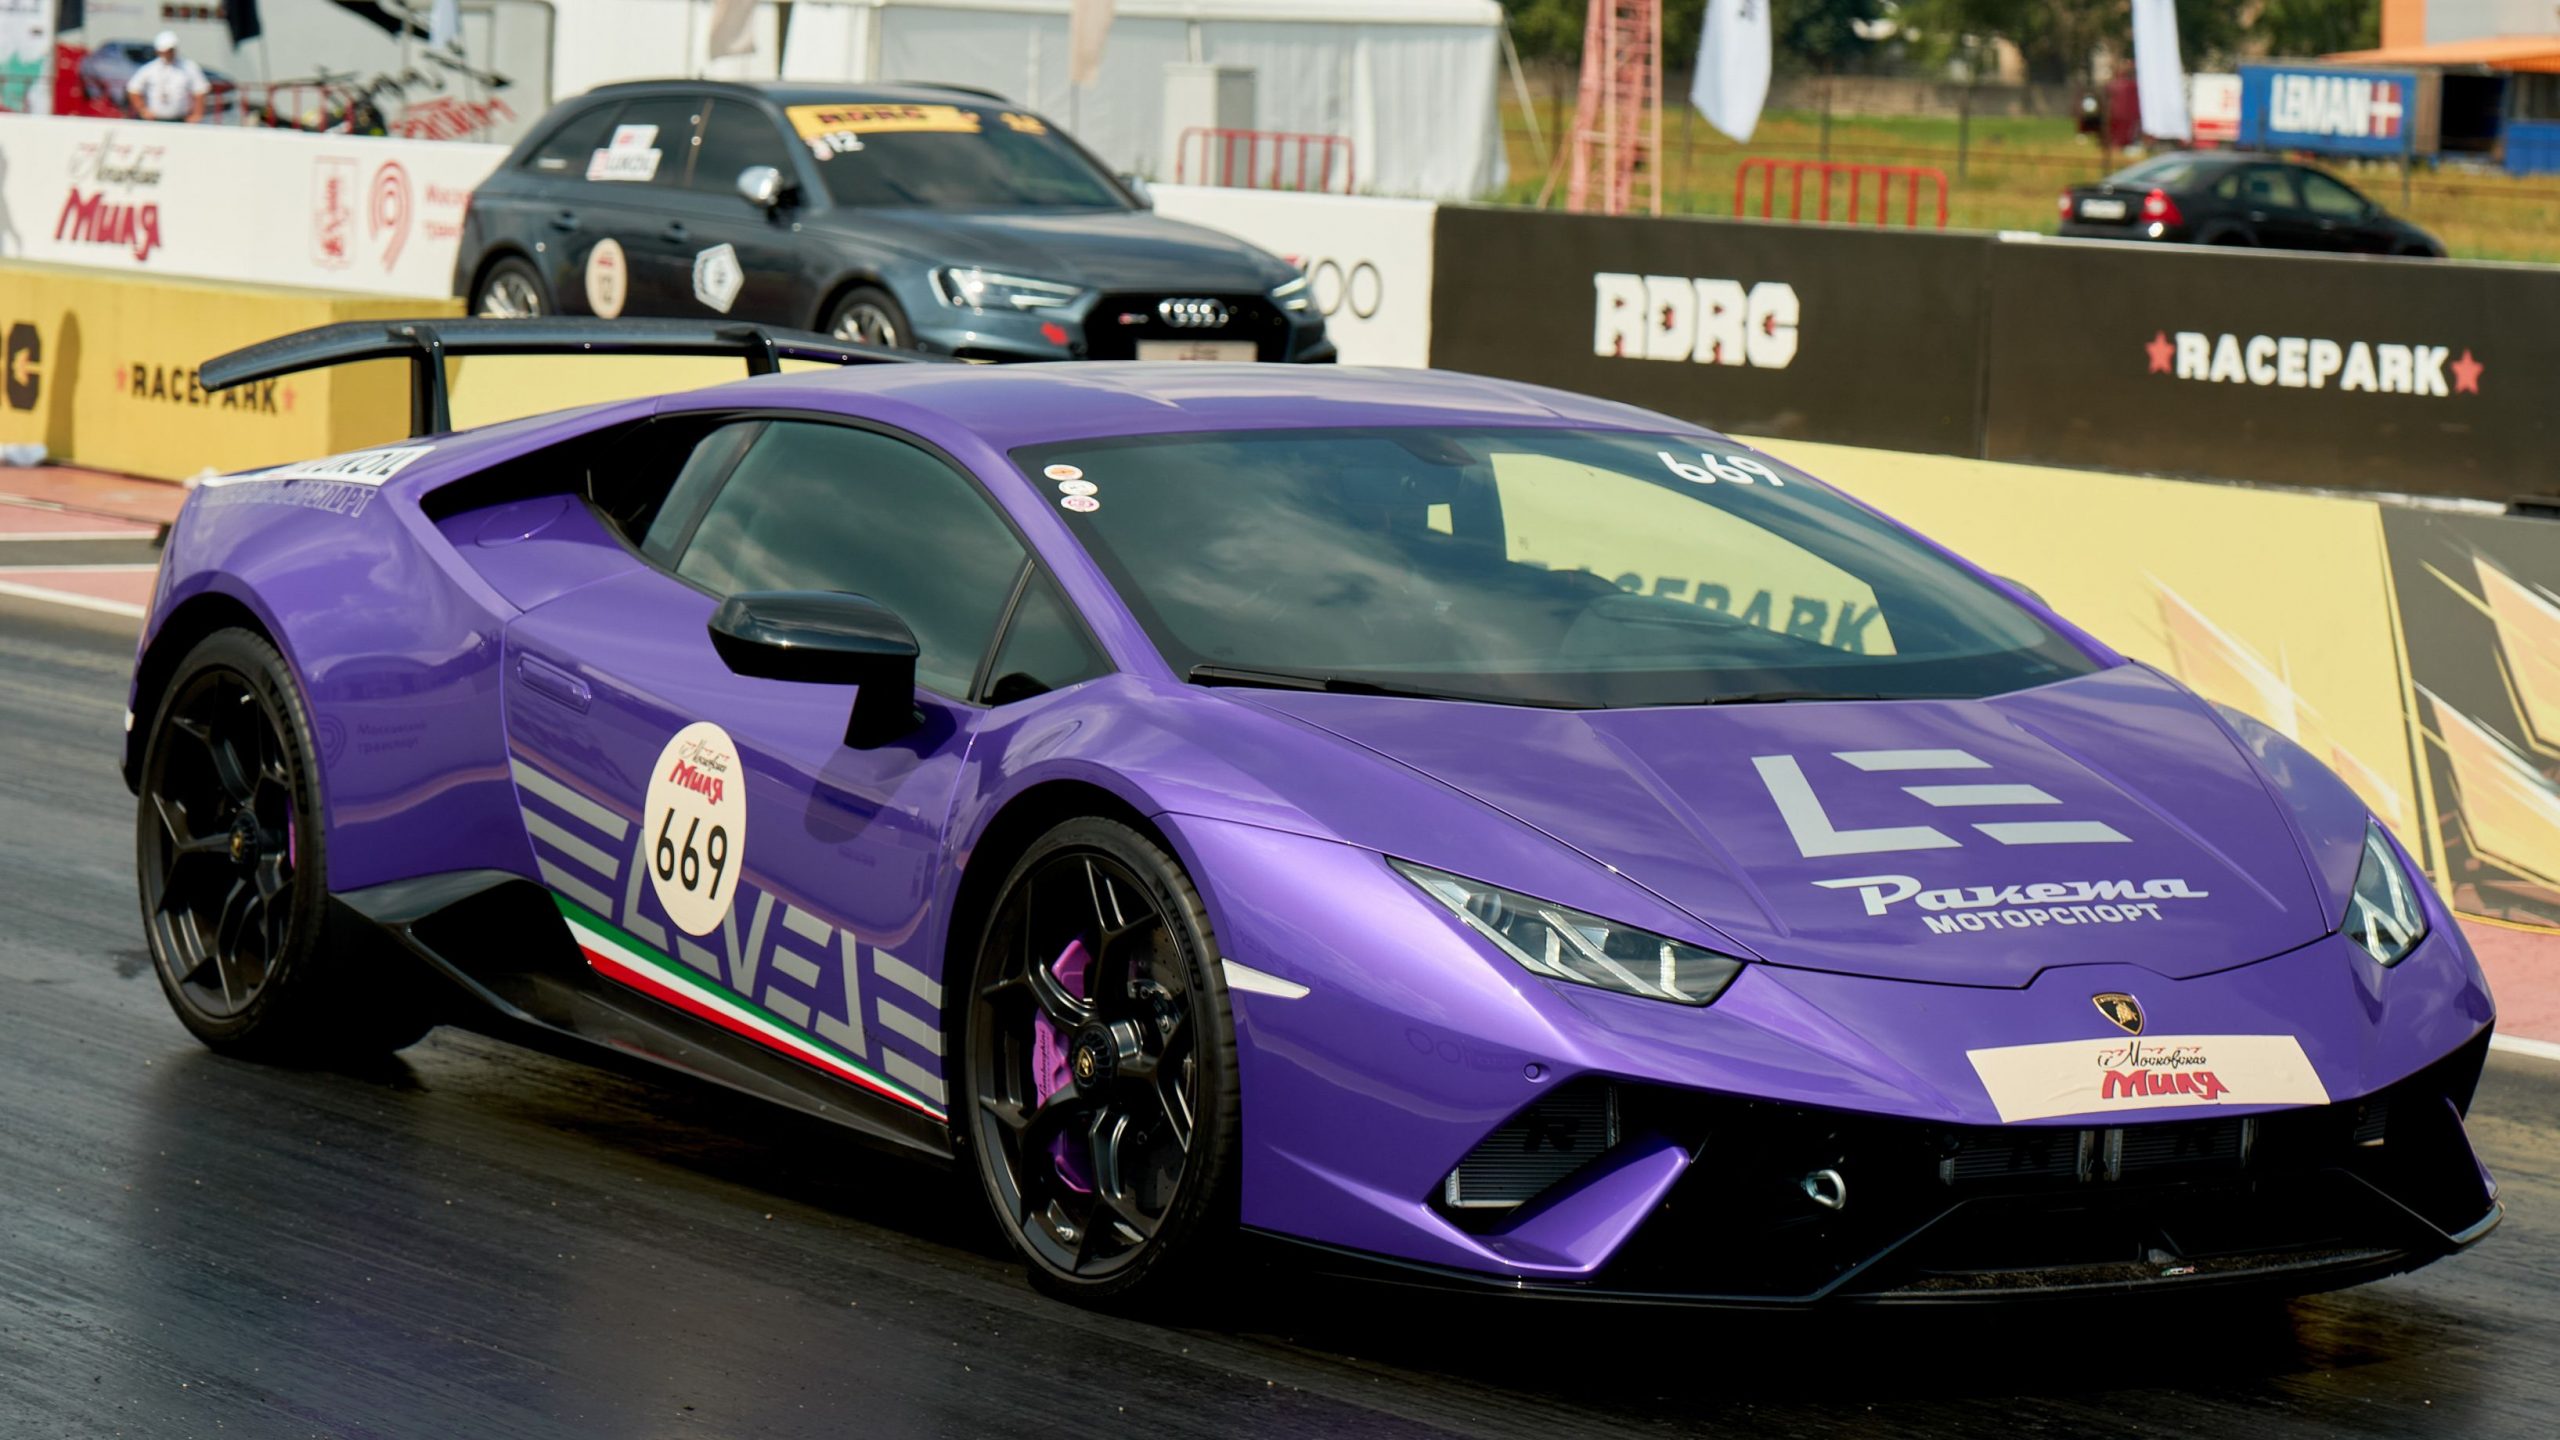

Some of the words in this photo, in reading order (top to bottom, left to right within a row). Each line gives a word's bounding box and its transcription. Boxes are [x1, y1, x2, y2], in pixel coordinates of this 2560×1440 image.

[55, 185, 162, 262] Миля
[2176, 331, 2449, 397] RACEPARK
[131, 363, 277, 414] RACEARK
[1657, 451, 1785, 487] 669
[669, 759, 723, 806] Миля
[657, 808, 727, 900] 669
[1921, 903, 2162, 934] МОТОРСПОРТ
[2098, 1040, 2206, 1069] Московская
[2101, 1069, 2230, 1100] Миля
